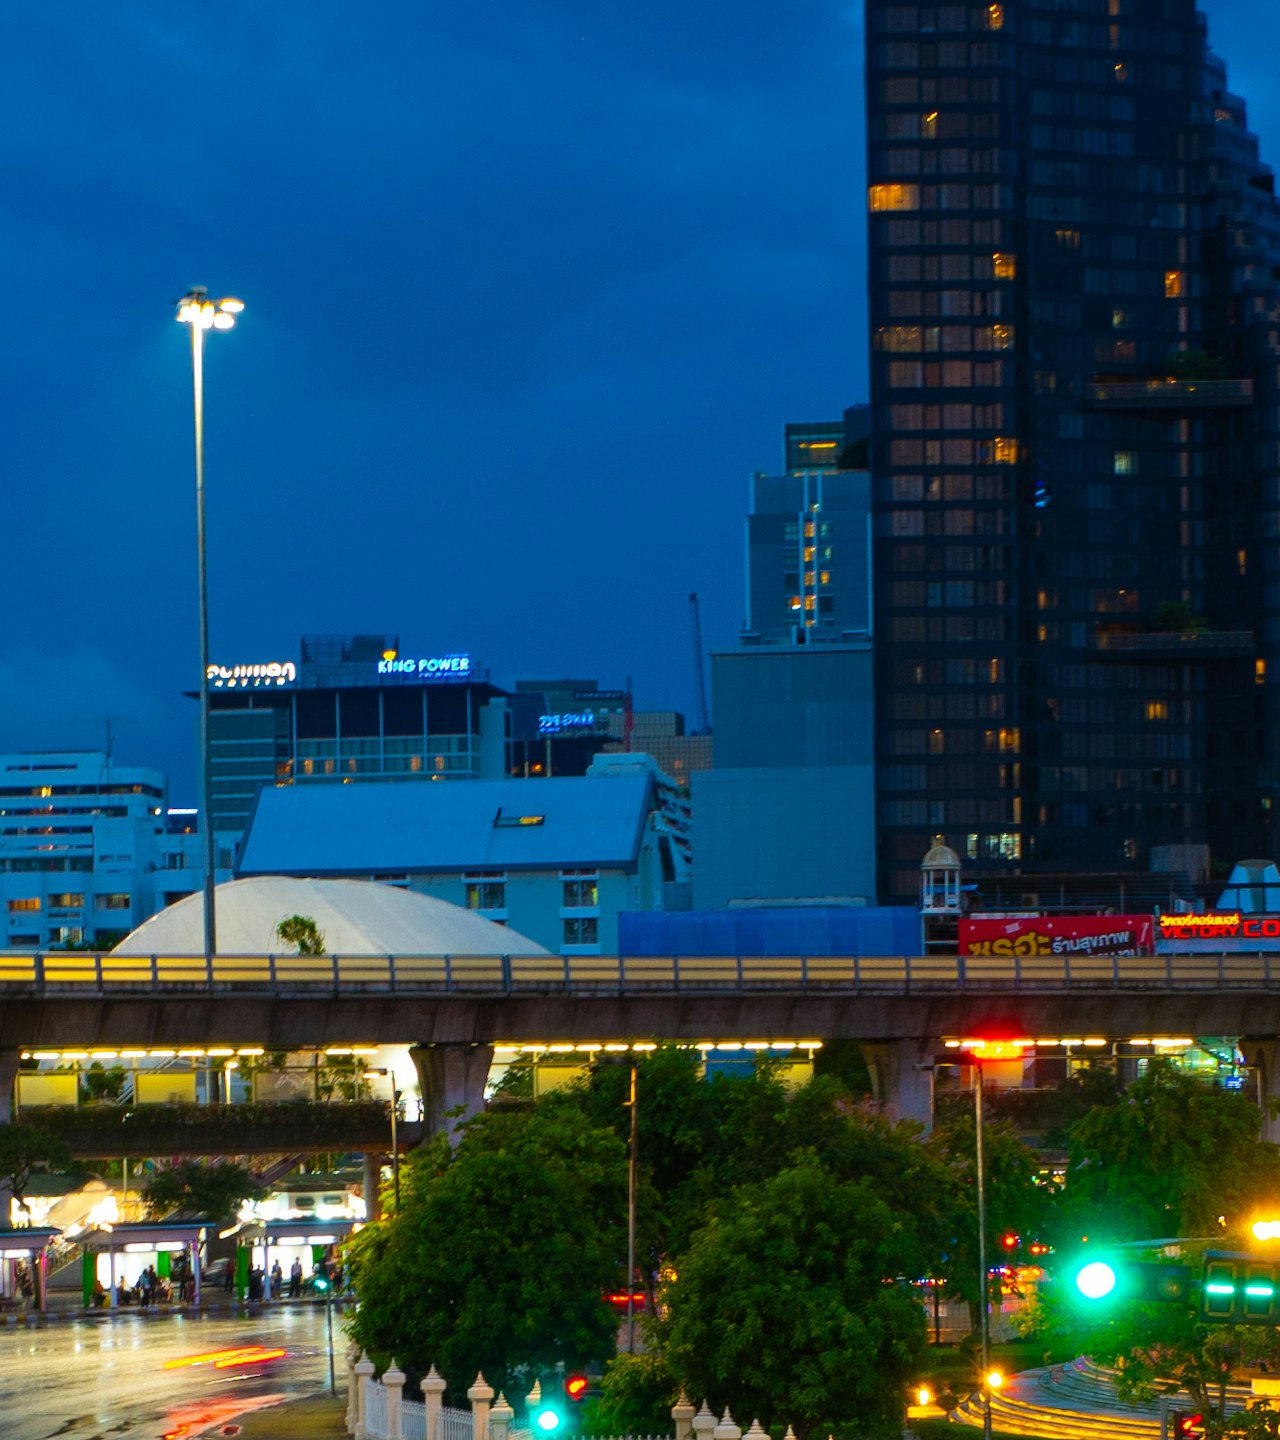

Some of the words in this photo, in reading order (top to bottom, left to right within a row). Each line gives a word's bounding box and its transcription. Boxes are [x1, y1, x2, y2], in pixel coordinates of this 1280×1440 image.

[378, 658, 416, 674] KING
[418, 657, 470, 672] POWER
[1161, 925, 1239, 939] VICTORY
